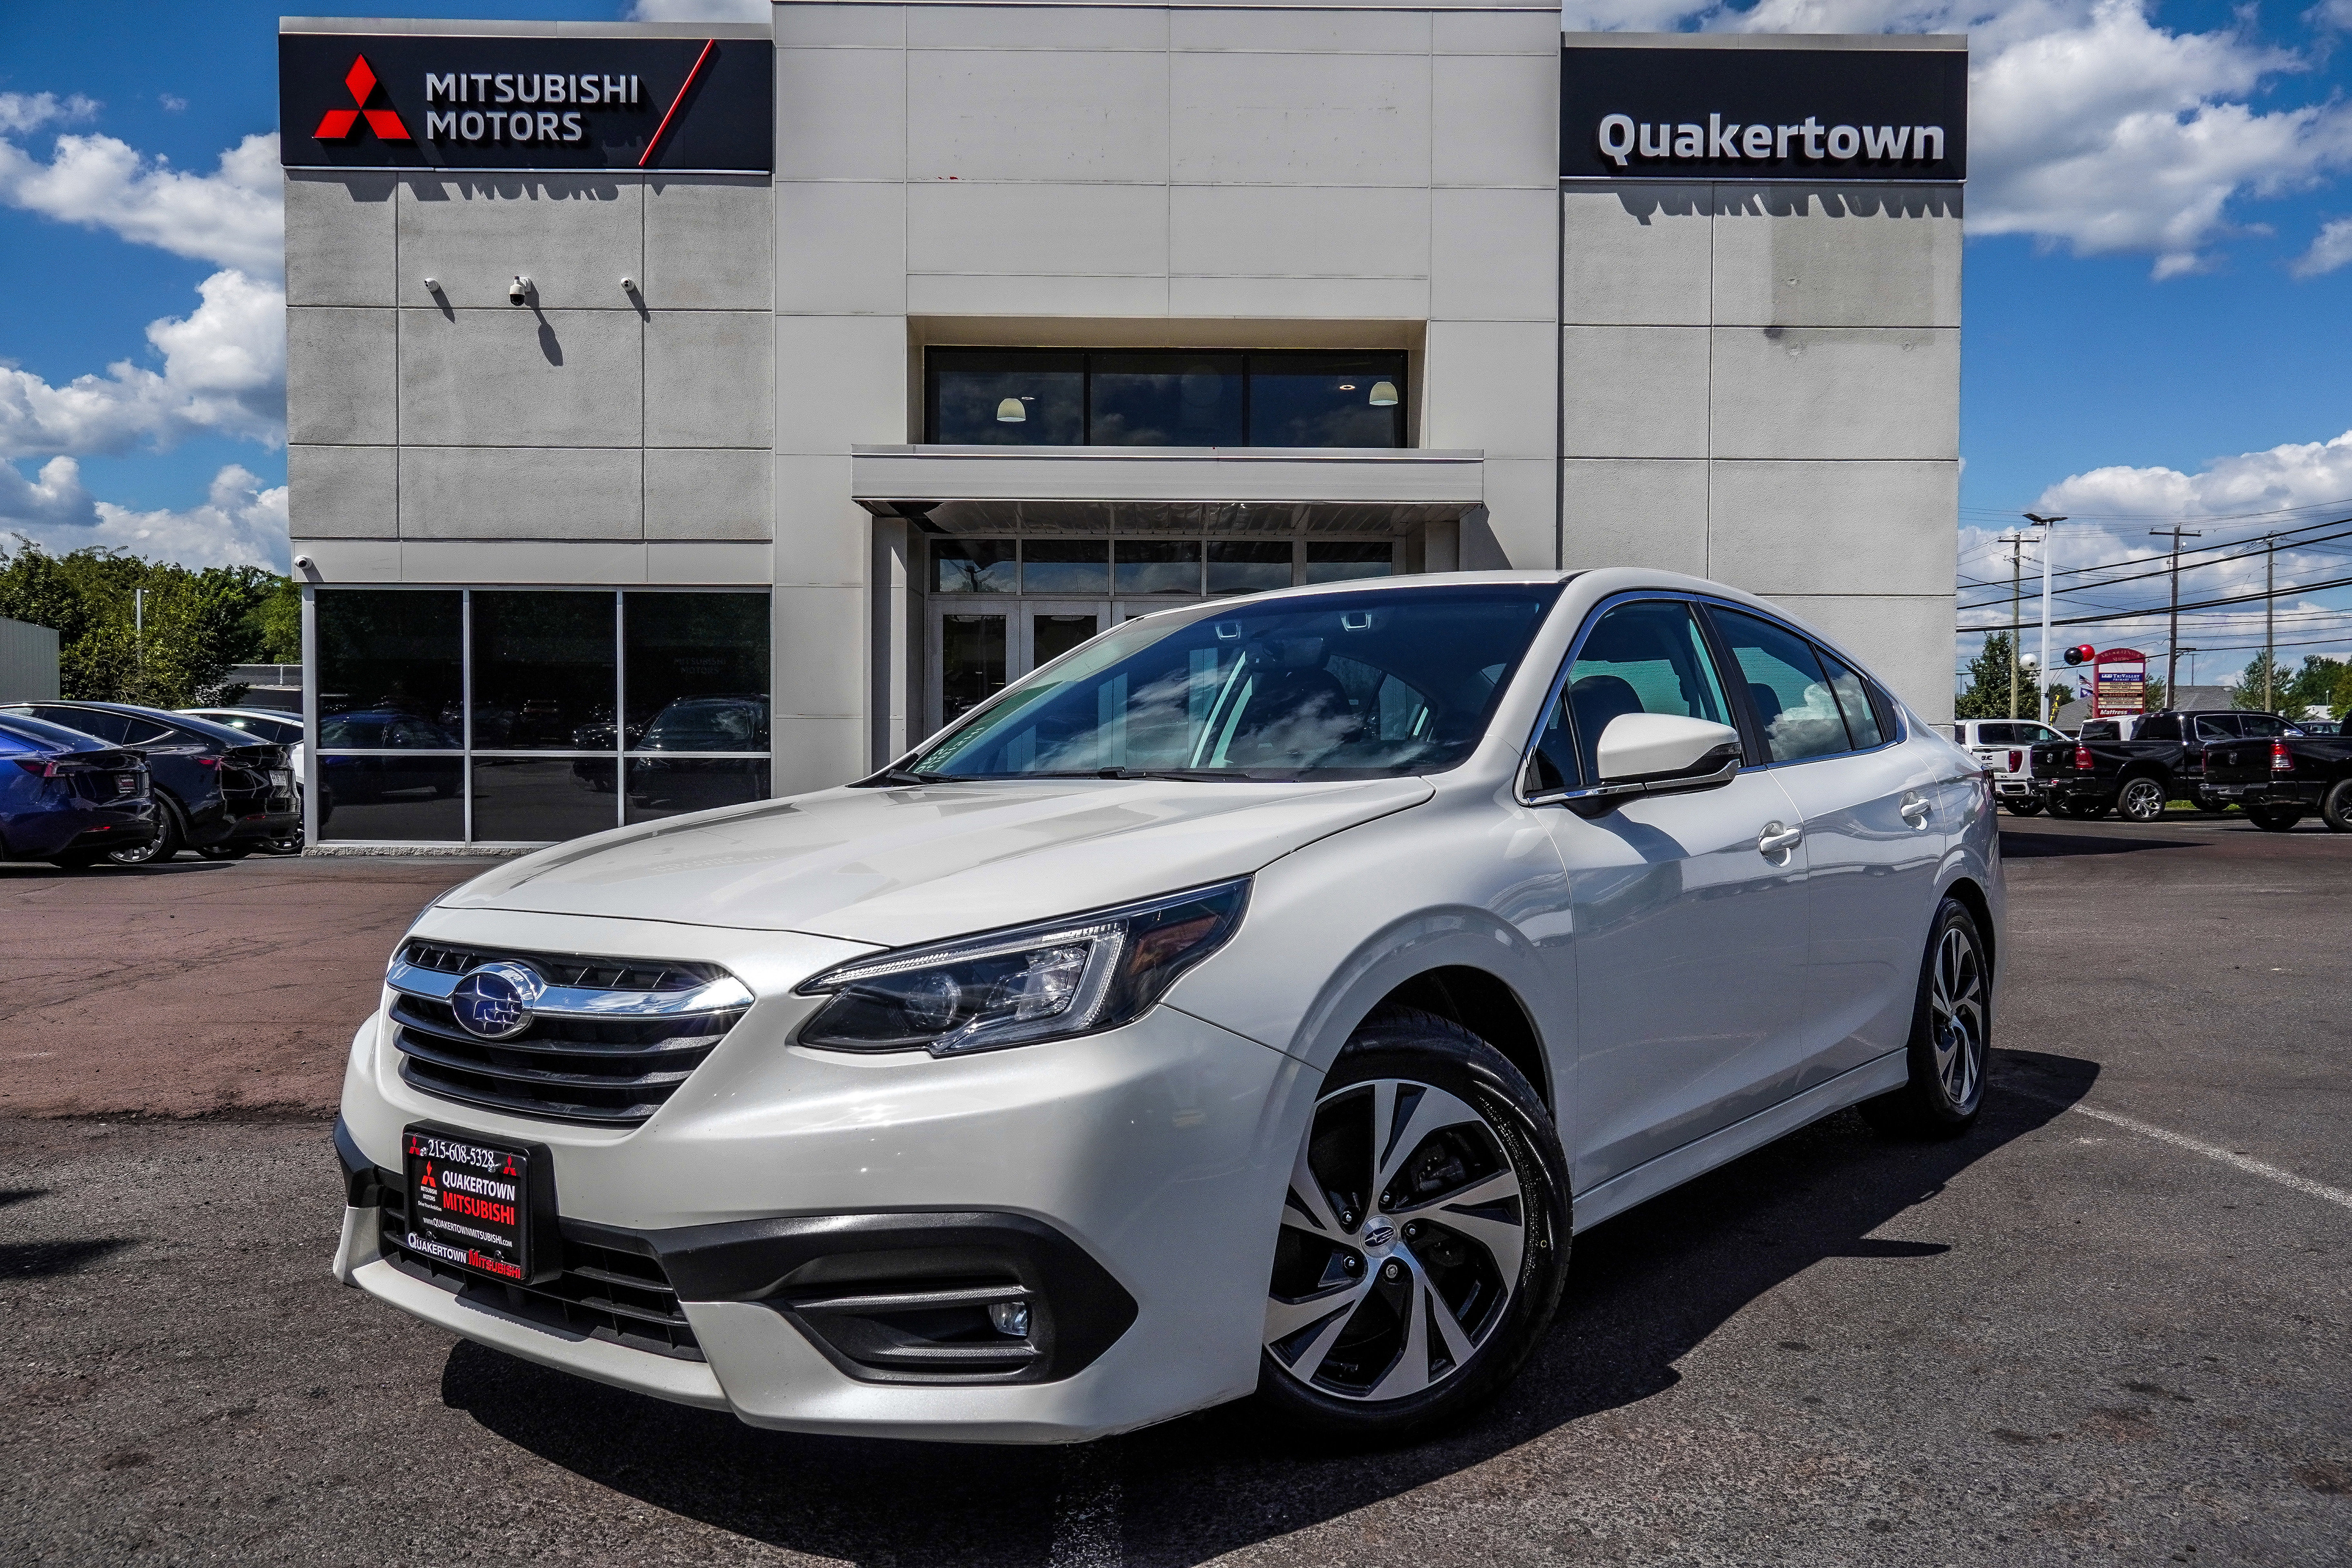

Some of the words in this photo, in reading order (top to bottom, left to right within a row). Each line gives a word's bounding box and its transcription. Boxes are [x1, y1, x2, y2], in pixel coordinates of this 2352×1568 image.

[426, 73, 638, 104] MITSUBISHI
[427, 111, 582, 141] MOTORS
[1599, 113, 1944, 165] Quakertown
[428, 1139, 494, 1168] 215-608-5328
[421, 1185, 437, 1195] MITSUBISHI
[423, 1193, 436, 1202] MOTORS
[443, 1170, 515, 1201] QUAKERTOWN
[443, 1191, 515, 1225] MITSUBISHI
[408, 1232, 467, 1263] QUAKERTOWN
[469, 1248, 521, 1279] MITSUBISHI
